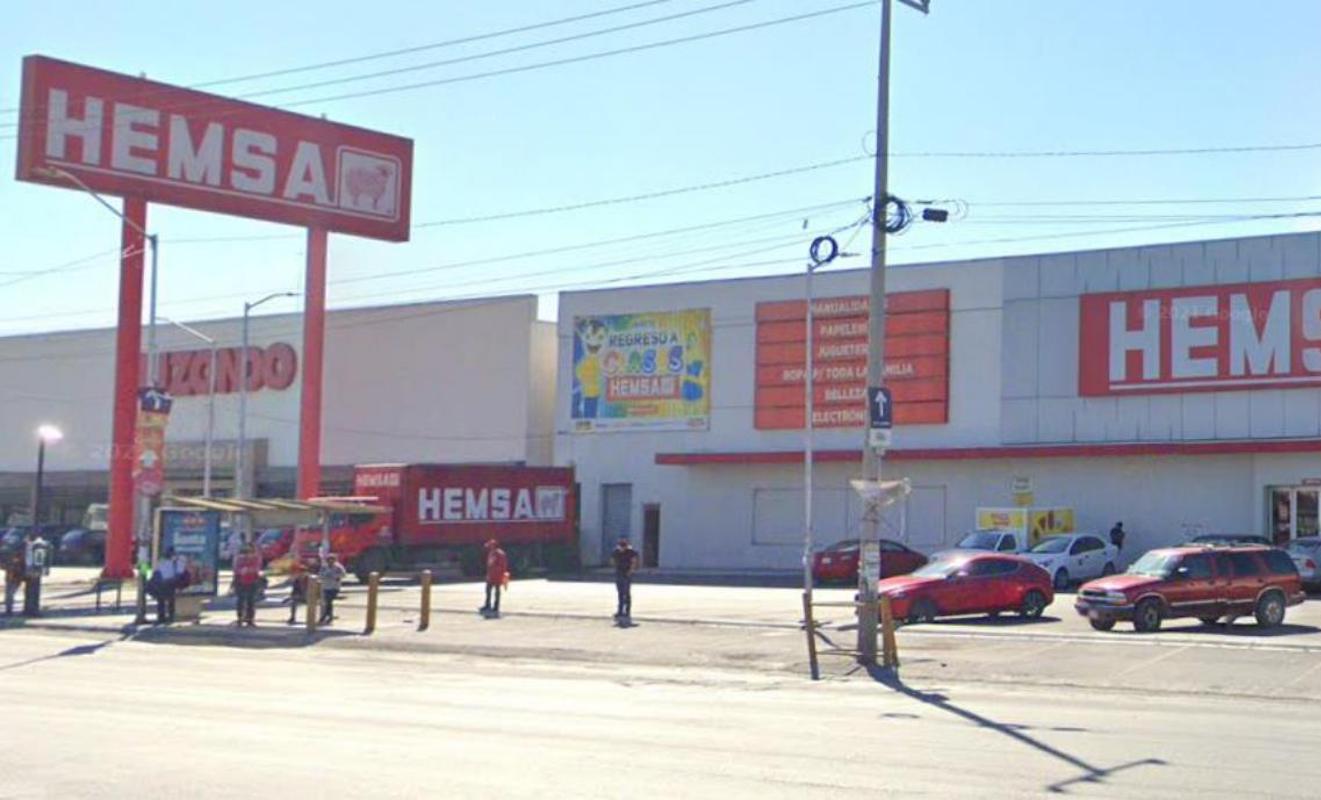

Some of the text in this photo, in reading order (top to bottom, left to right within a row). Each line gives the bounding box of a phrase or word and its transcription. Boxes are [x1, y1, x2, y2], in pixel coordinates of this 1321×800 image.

[47, 88, 331, 205] HEMSA
[608, 332, 667, 347] REGRESO
[613, 377, 660, 399] HEMSA
[419, 487, 532, 520] HEMSA
